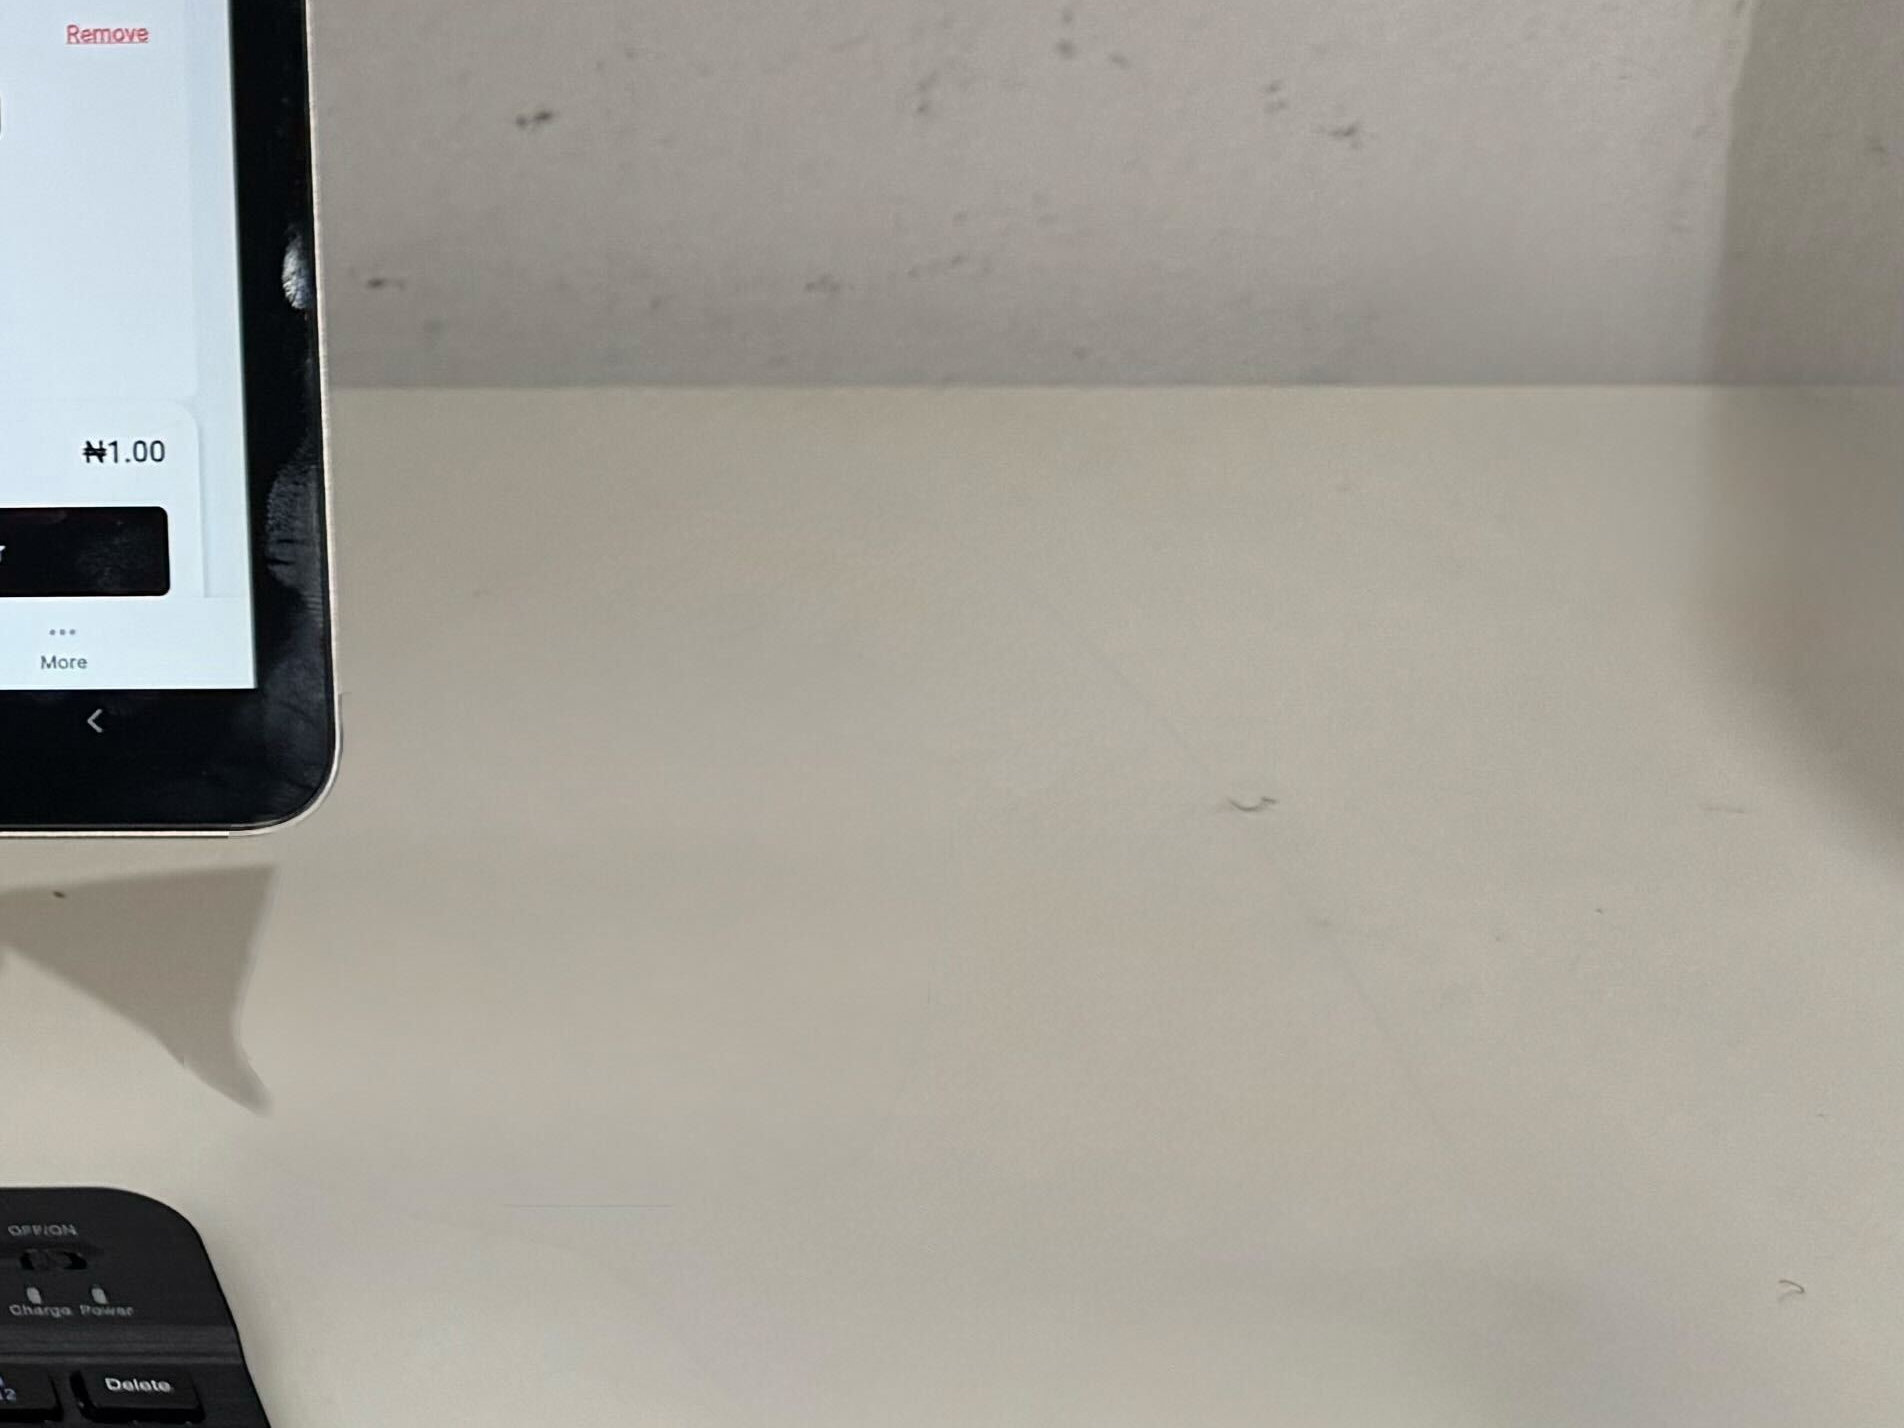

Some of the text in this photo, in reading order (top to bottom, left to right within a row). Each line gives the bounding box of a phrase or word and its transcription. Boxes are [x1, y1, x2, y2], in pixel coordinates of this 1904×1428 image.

[66, 25, 149, 44] Remove
[83, 440, 165, 463] ₦1.00
[41, 655, 87, 669] More
[105, 1378, 171, 1392] Delete
